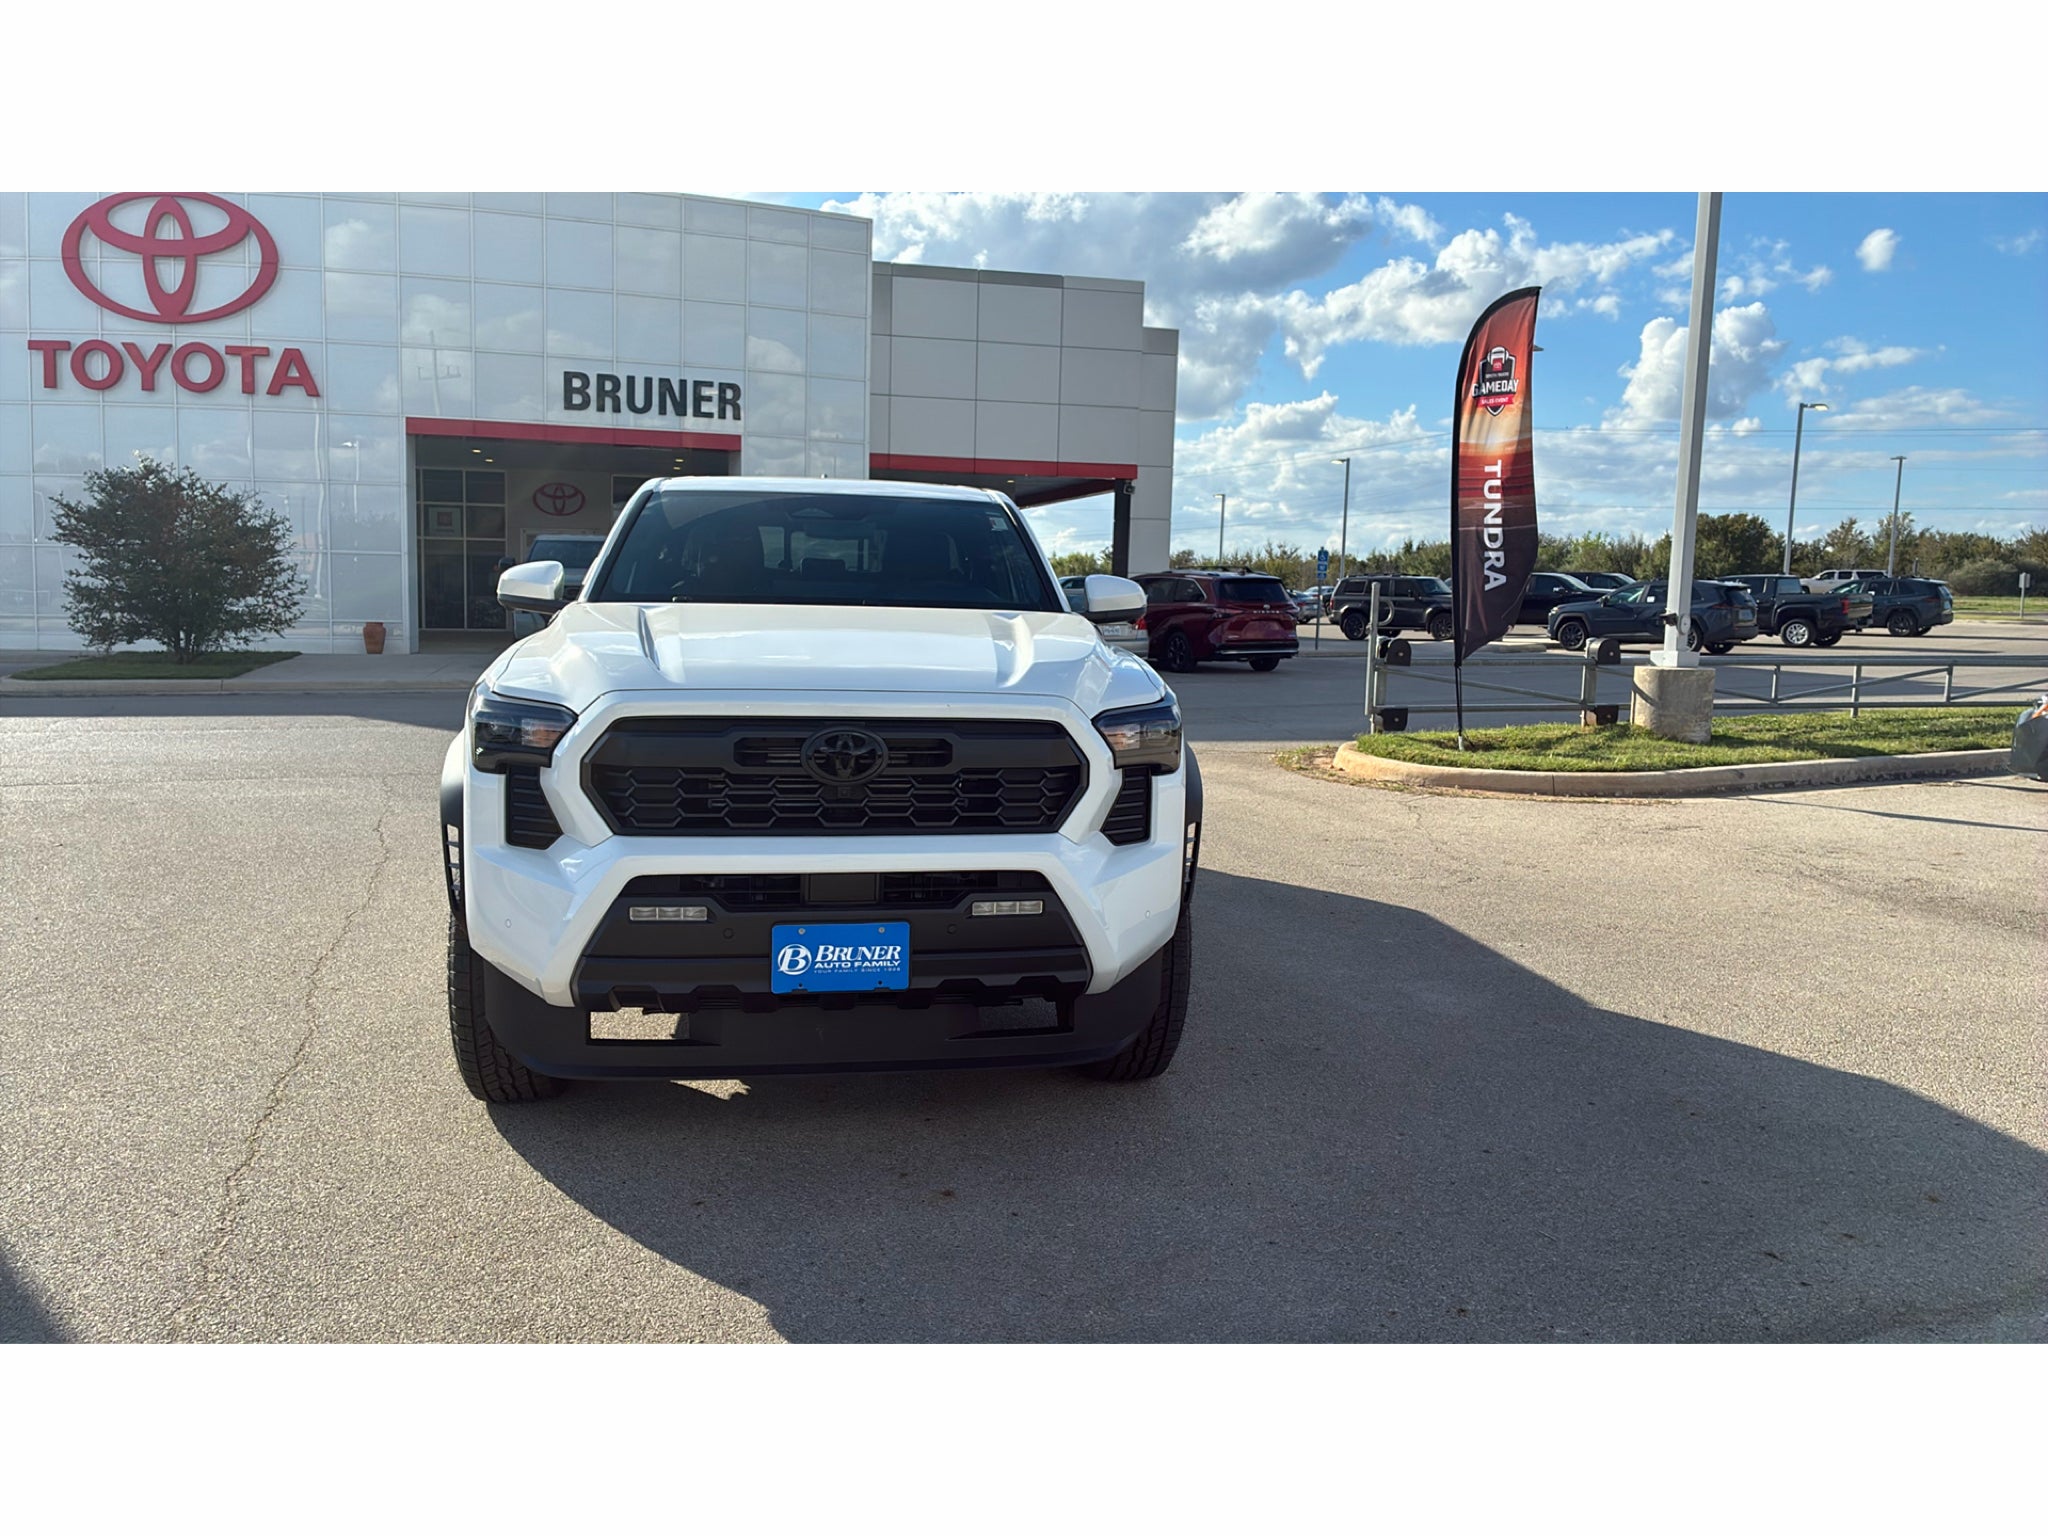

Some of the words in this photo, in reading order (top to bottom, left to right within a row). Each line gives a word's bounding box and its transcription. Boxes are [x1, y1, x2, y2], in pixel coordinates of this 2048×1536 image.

[28, 339, 320, 397] TOYOTA
[563, 371, 742, 421] BRUNER
[1472, 379, 1519, 397] GAMEDAY
[1484, 459, 1507, 591] TUNDRA
[815, 945, 901, 962] BRUNER
[815, 961, 851, 969] AUTO
[854, 960, 901, 968] FAMILY
